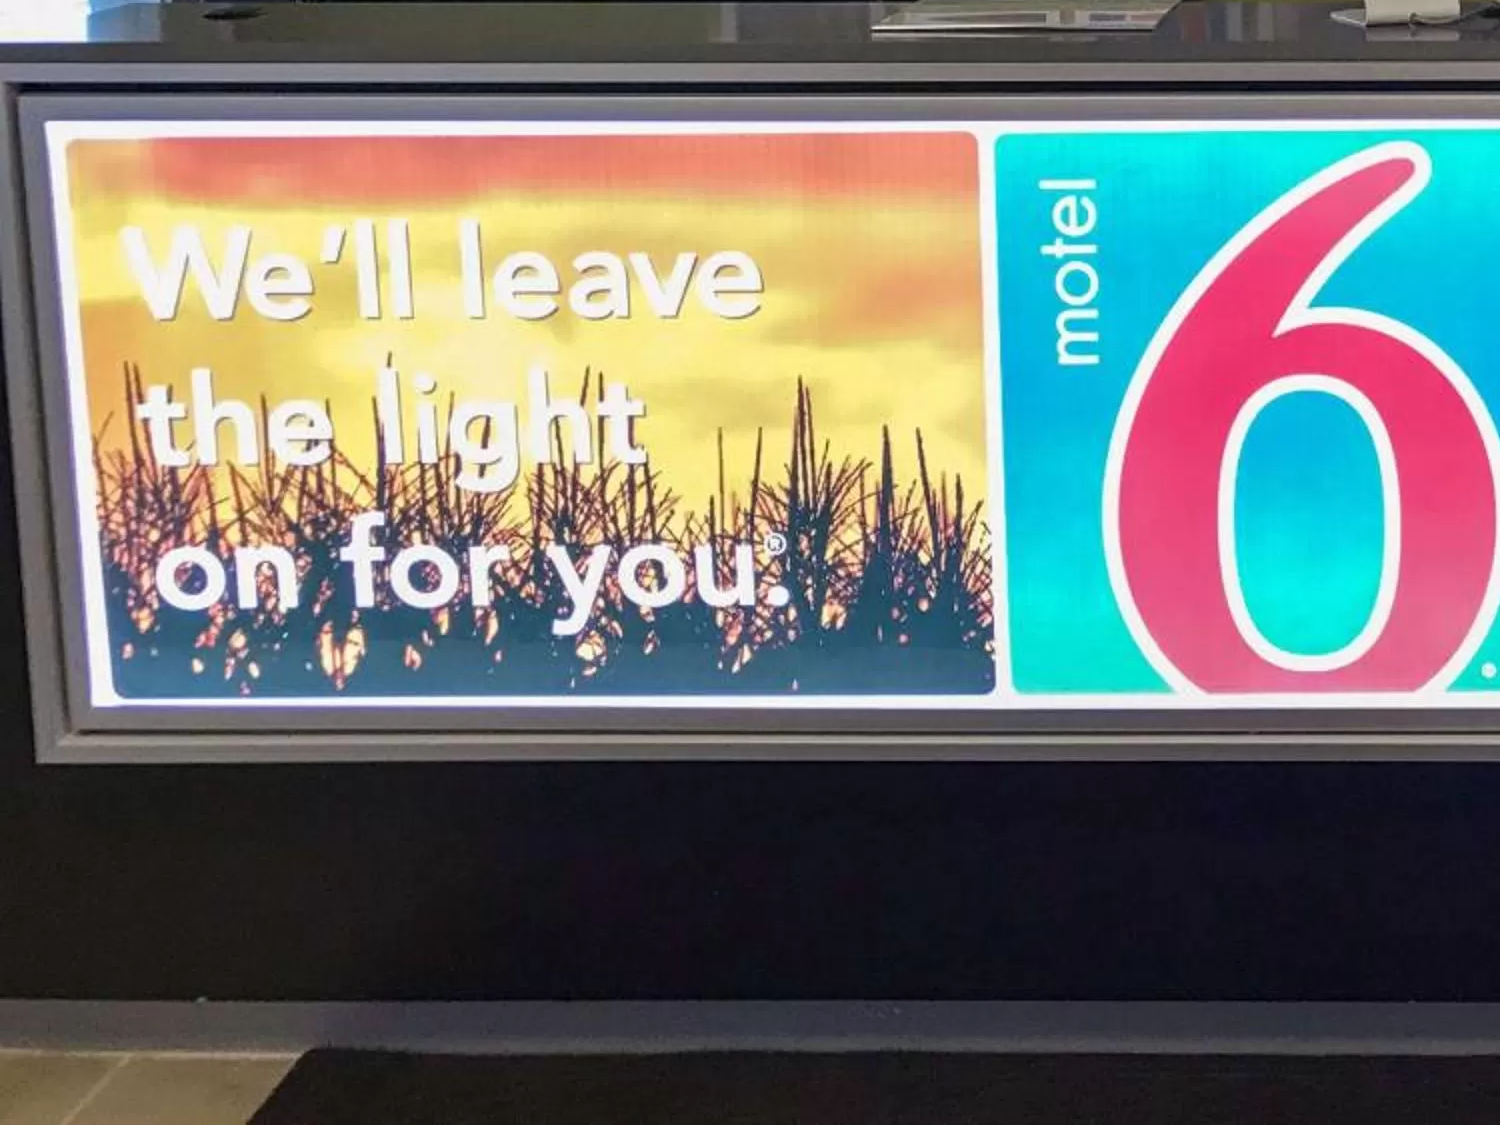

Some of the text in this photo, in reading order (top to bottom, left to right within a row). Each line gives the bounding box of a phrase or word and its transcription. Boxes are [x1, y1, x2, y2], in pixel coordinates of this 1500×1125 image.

[121, 218, 766, 322] We'll leave
[1038, 178, 1099, 366] motel
[138, 365, 649, 493] the light
[154, 543, 298, 611] on
[340, 510, 512, 611] for
